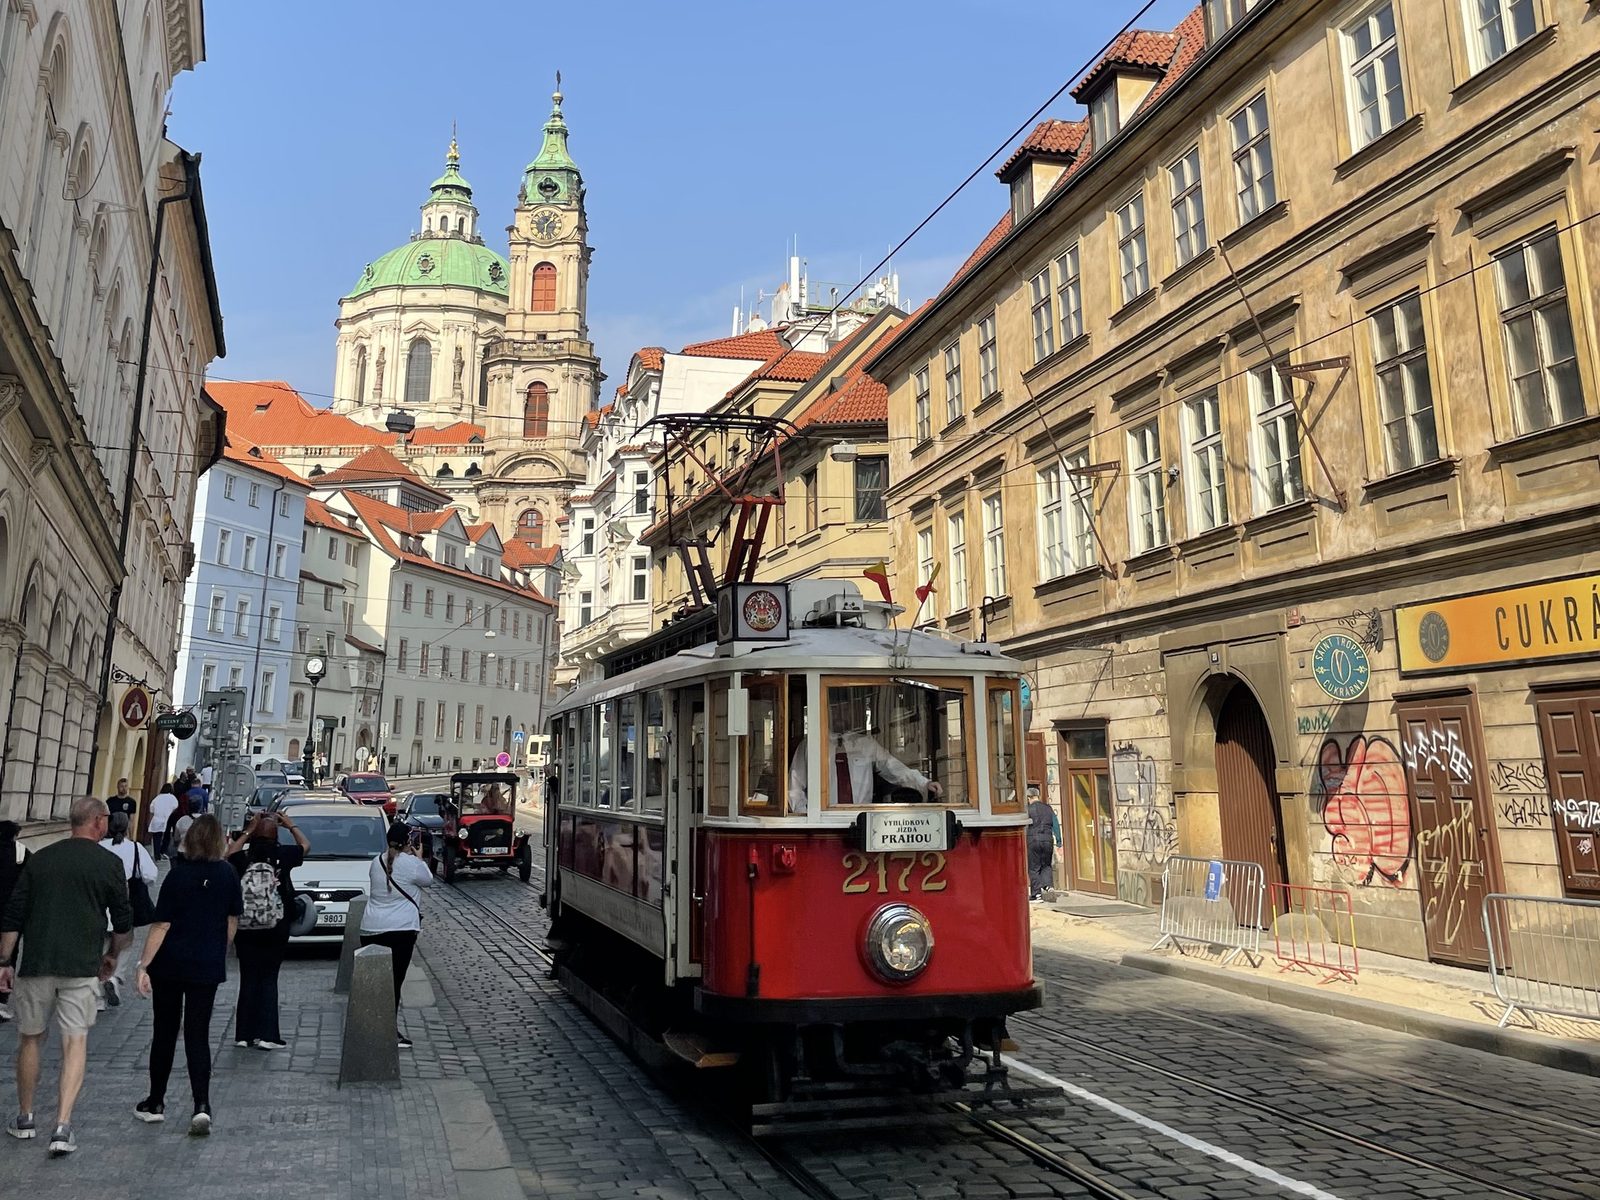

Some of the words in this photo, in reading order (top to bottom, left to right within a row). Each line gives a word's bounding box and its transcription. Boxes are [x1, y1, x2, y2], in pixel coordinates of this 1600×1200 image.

[1315, 638, 1334, 661] SAINT
[1336, 637, 1364, 660] TROPEZ
[881, 834, 932, 843] PRAHOU
[843, 852, 946, 893] 2172
